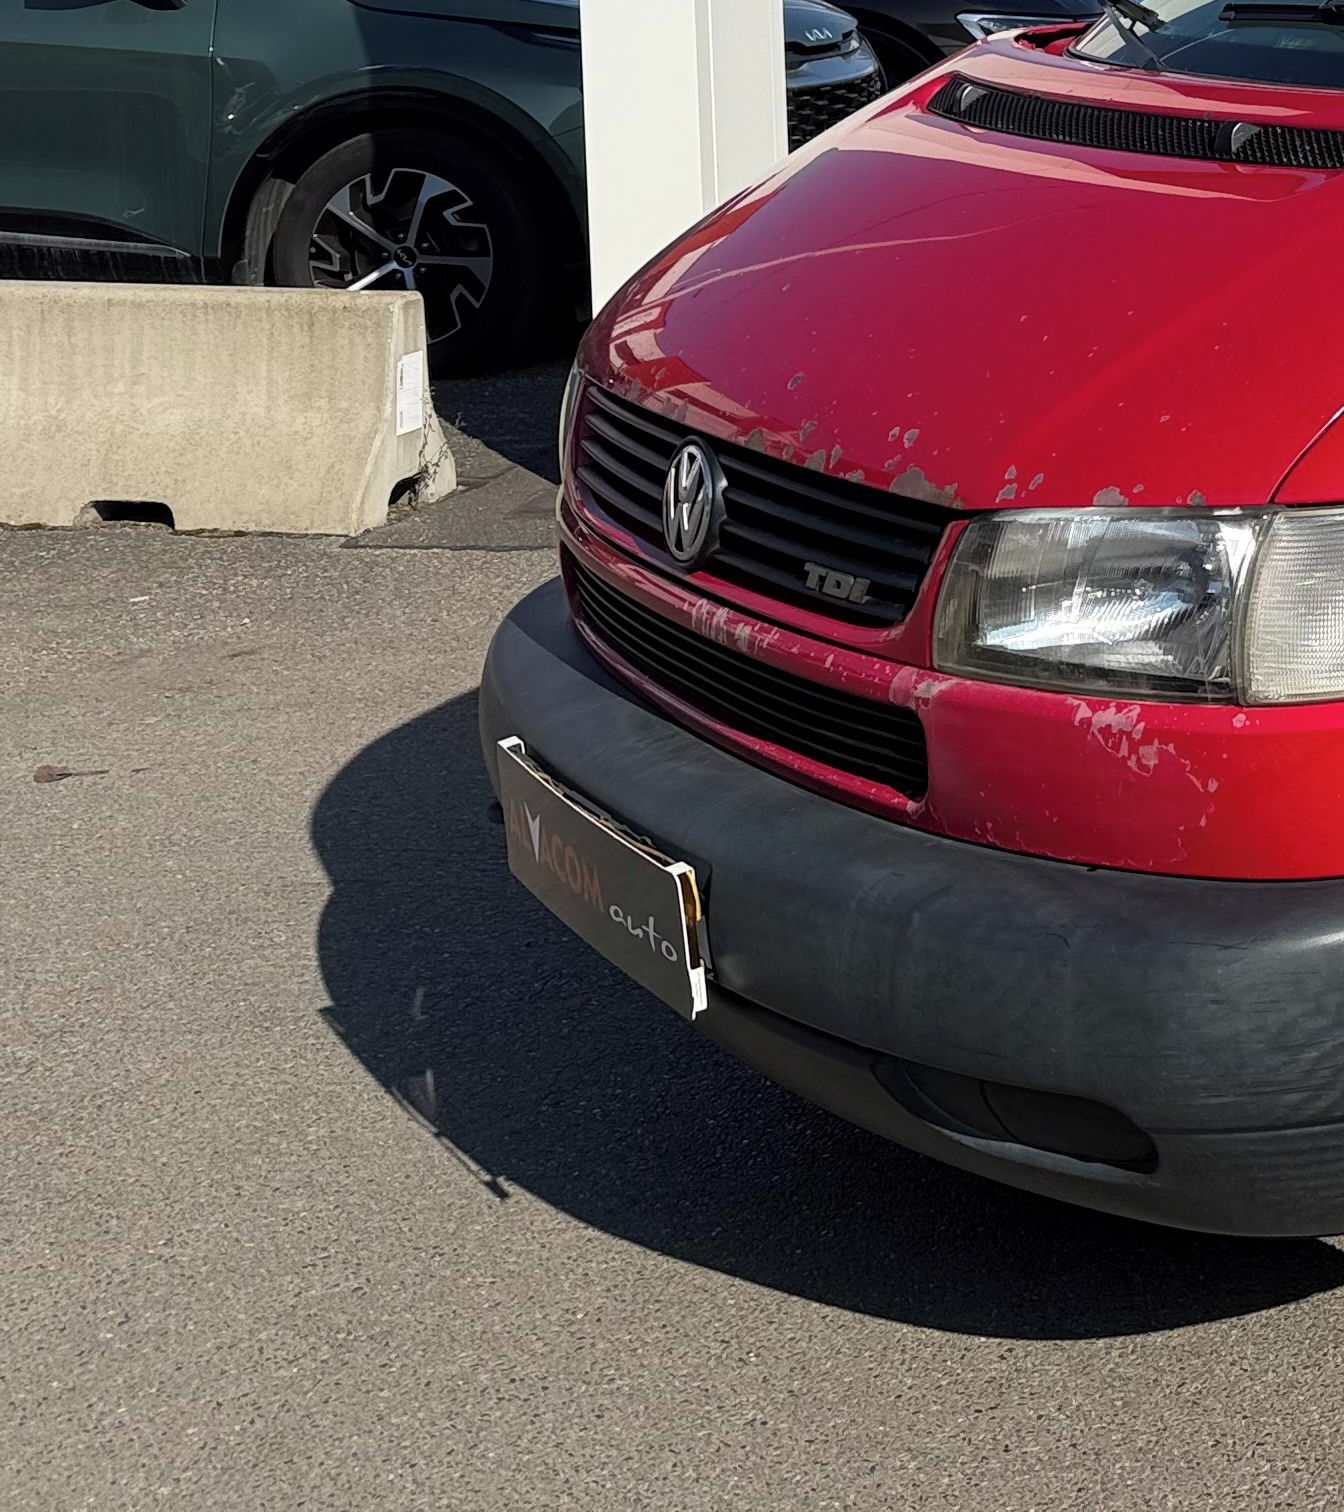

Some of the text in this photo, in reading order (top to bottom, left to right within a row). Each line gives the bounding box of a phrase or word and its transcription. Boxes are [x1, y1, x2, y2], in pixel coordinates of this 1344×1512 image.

[803, 561, 872, 604] TDI
[507, 796, 679, 963] ALVACOM auto
